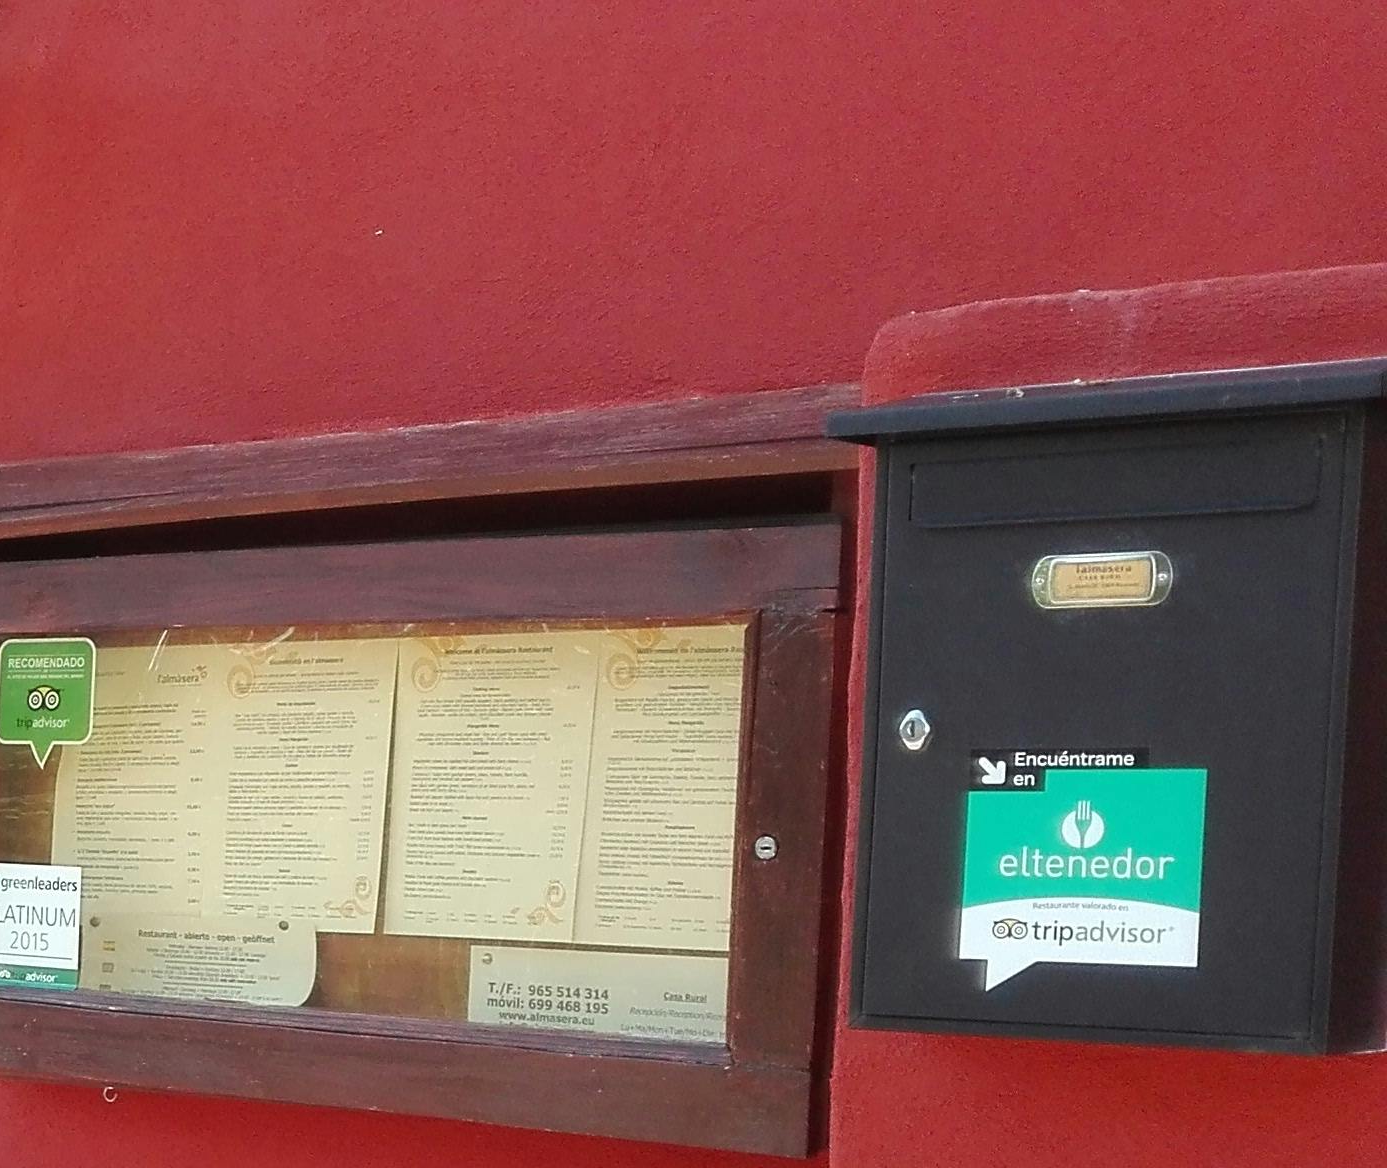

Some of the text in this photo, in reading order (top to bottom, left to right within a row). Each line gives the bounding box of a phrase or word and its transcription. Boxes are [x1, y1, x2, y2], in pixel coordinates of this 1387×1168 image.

[8, 657, 85, 669] RECOMENDADO
[17, 716, 67, 730] tripadvisor
[1013, 750, 1135, 767] Encuéntrame
[1013, 774, 1035, 787] en
[998, 845, 1175, 880] eltenedor
[1, 875, 78, 892] greenleaders
[1032, 902, 1080, 910] Restaurante
[1081, 901, 1117, 911] valorado
[10, 930, 49, 951] 2015
[1031, 920, 1168, 946] tripadvisor
[528, 984, 553, 997] 965
[556, 986, 581, 998] 514
[584, 987, 609, 1000] 314
[528, 998, 553, 1011] 699
[556, 1000, 581, 1013] 468
[585, 1001, 609, 1015] 195
